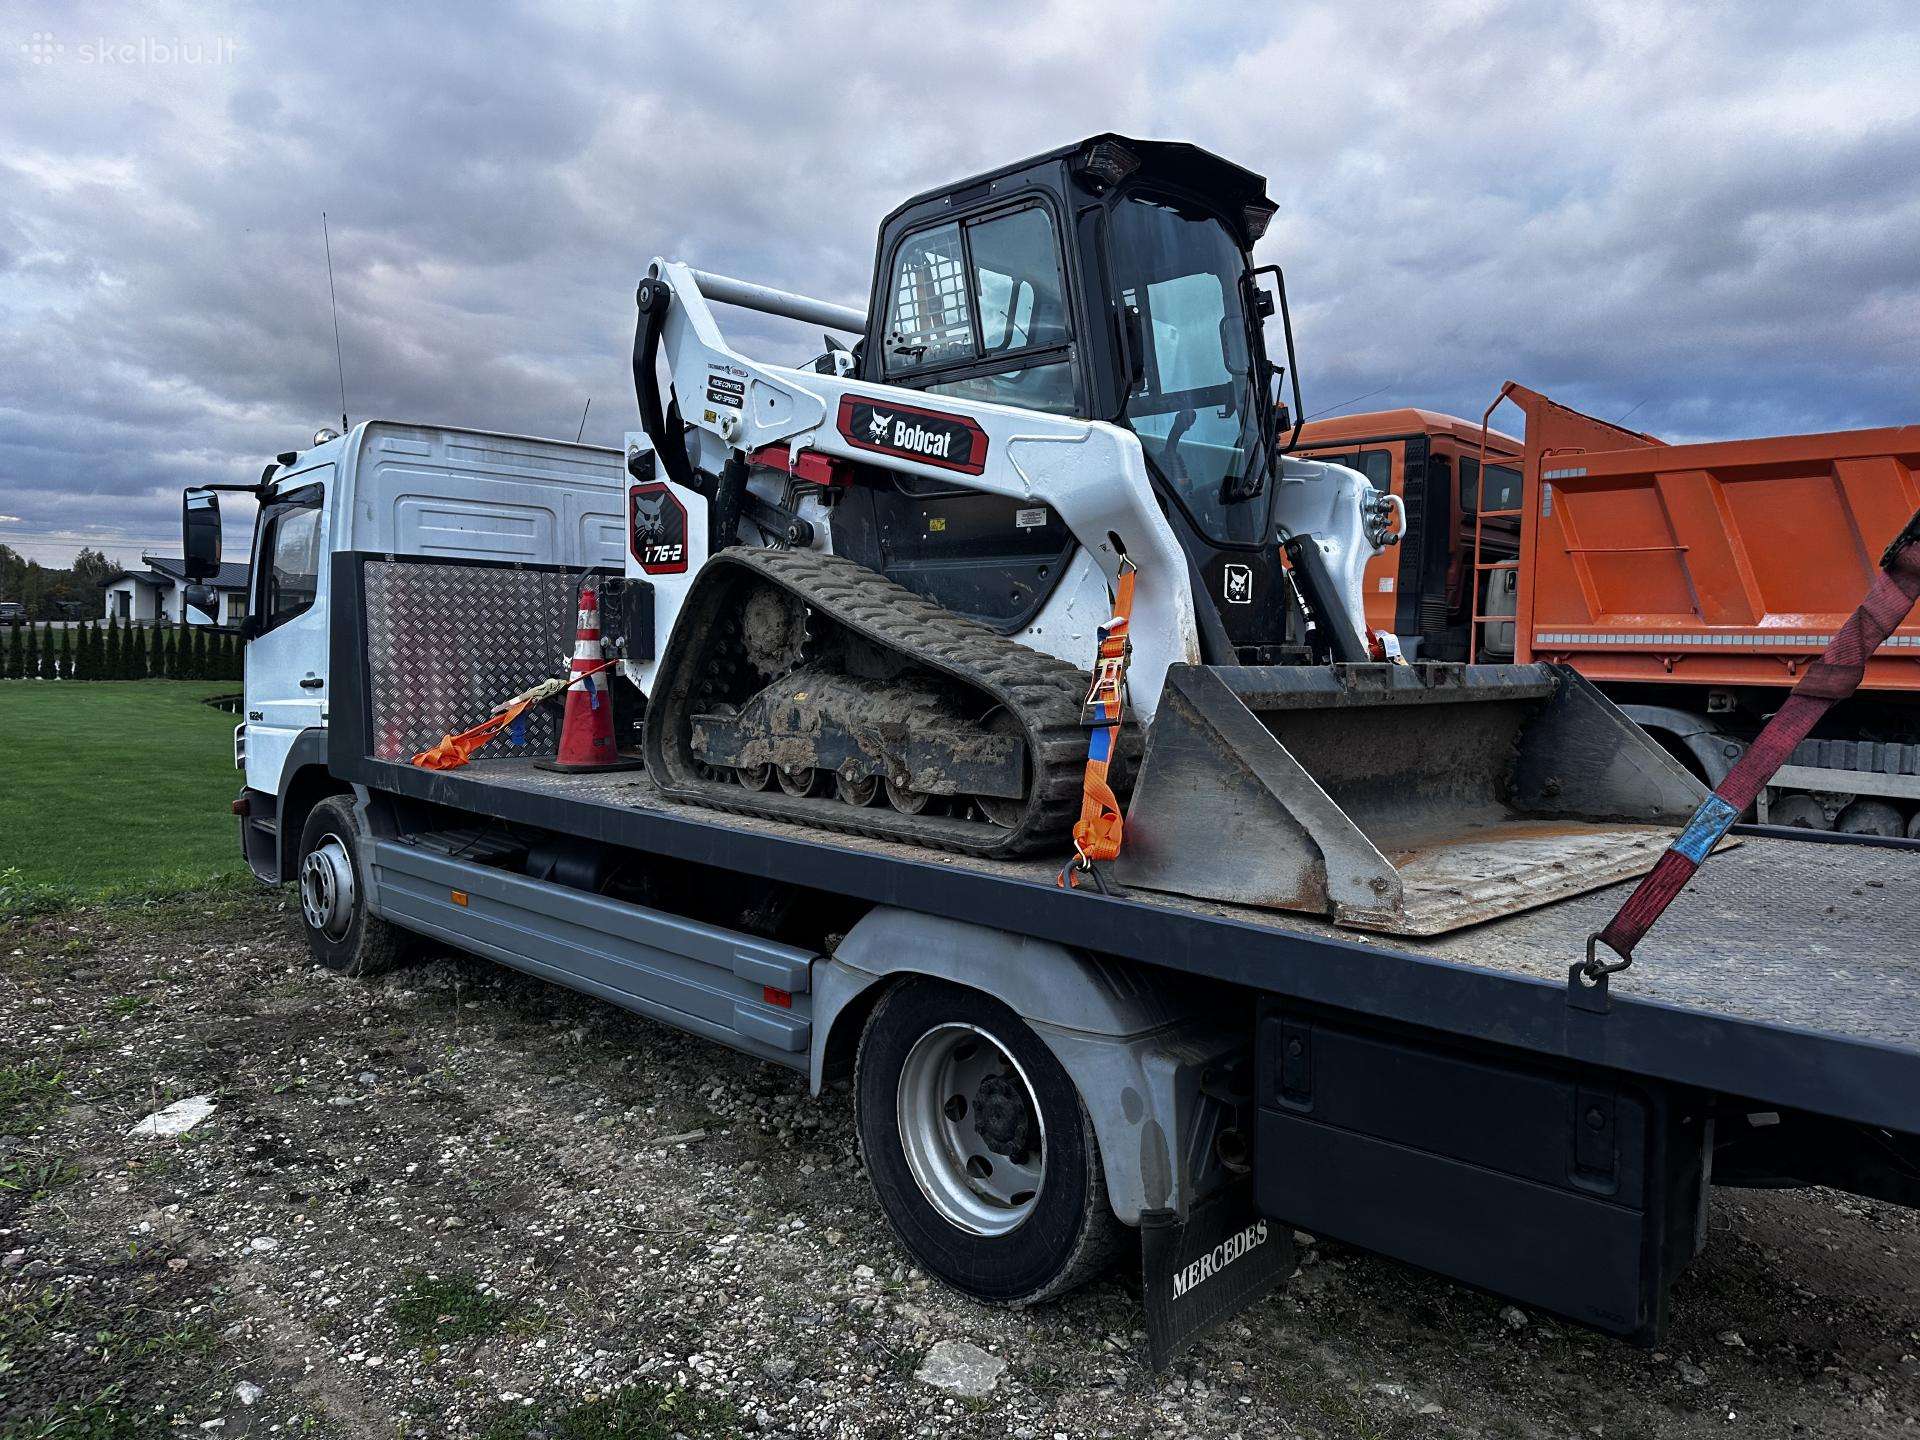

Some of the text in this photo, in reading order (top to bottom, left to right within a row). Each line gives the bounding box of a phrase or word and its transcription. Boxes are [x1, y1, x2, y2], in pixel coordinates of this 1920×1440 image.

[893, 420, 951, 458] Bobcat
[645, 544, 683, 563] T76-2
[1172, 1218, 1268, 1301] MERCEDES
